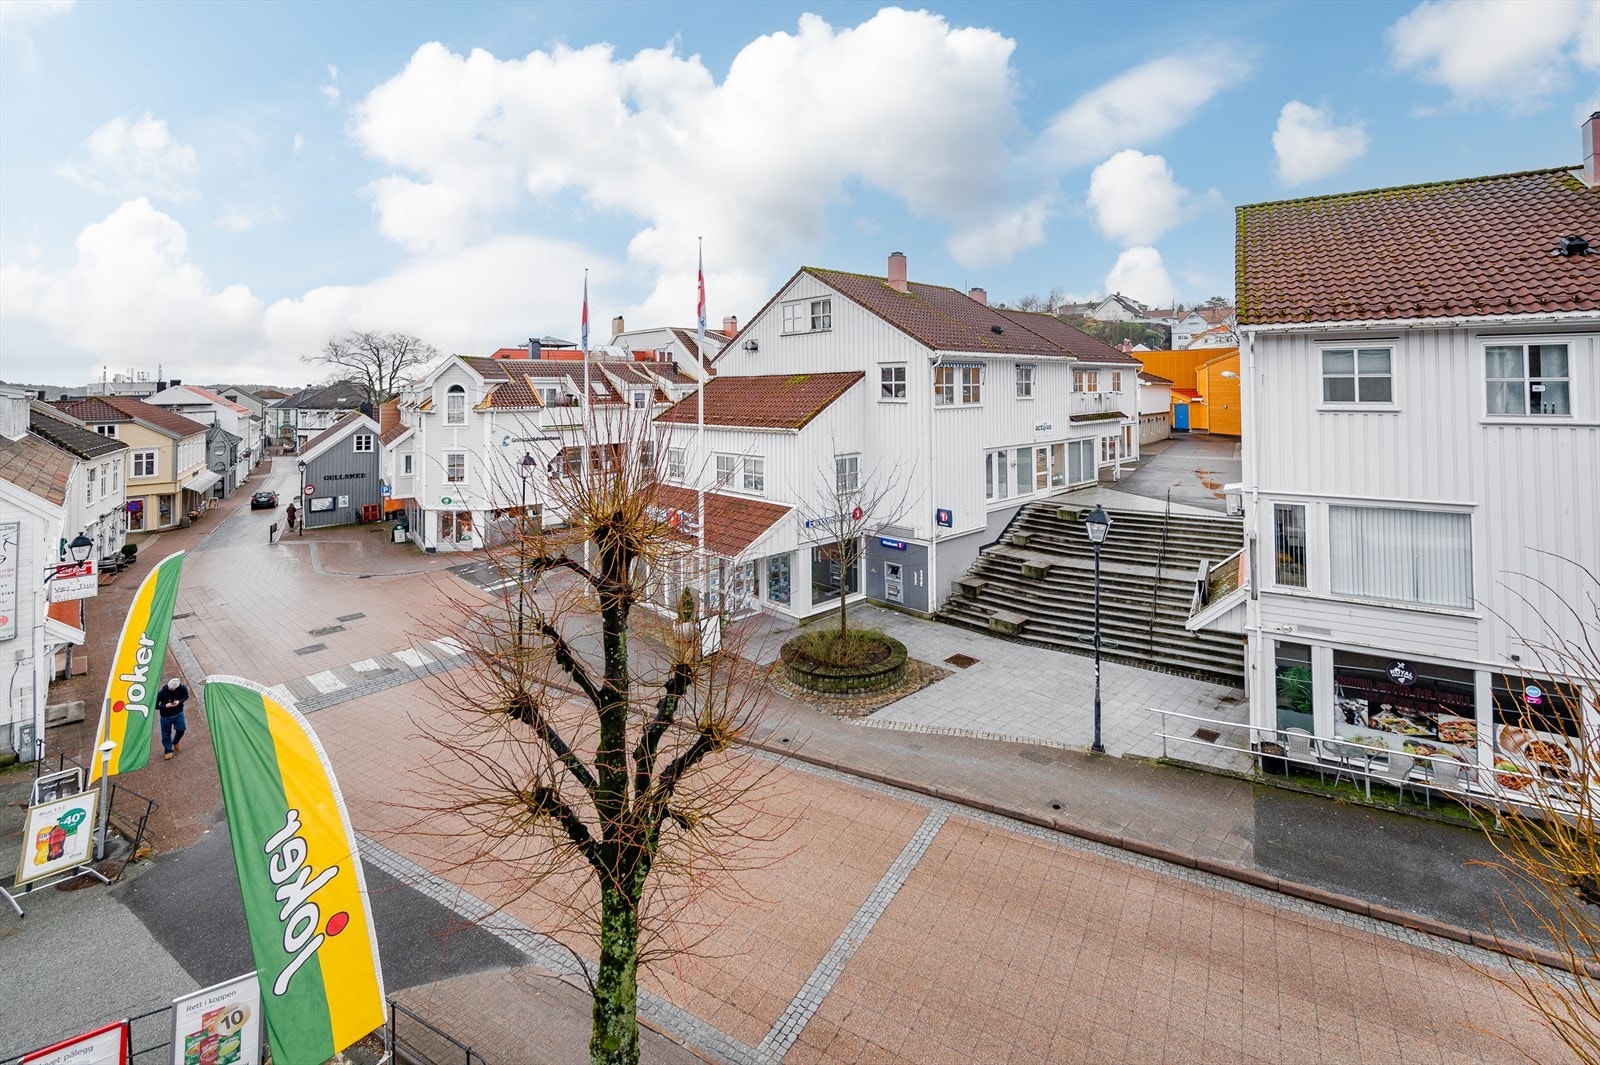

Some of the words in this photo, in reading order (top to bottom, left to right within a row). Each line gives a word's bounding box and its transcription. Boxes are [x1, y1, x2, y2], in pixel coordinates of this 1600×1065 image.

[1389, 668, 1413, 677] ROYAL
[186, 1002, 203, 1012] Rett
[208, 990, 237, 1004] koppen
[220, 1009, 244, 1030] 10
[63, 1045, 94, 1062] pålegg
